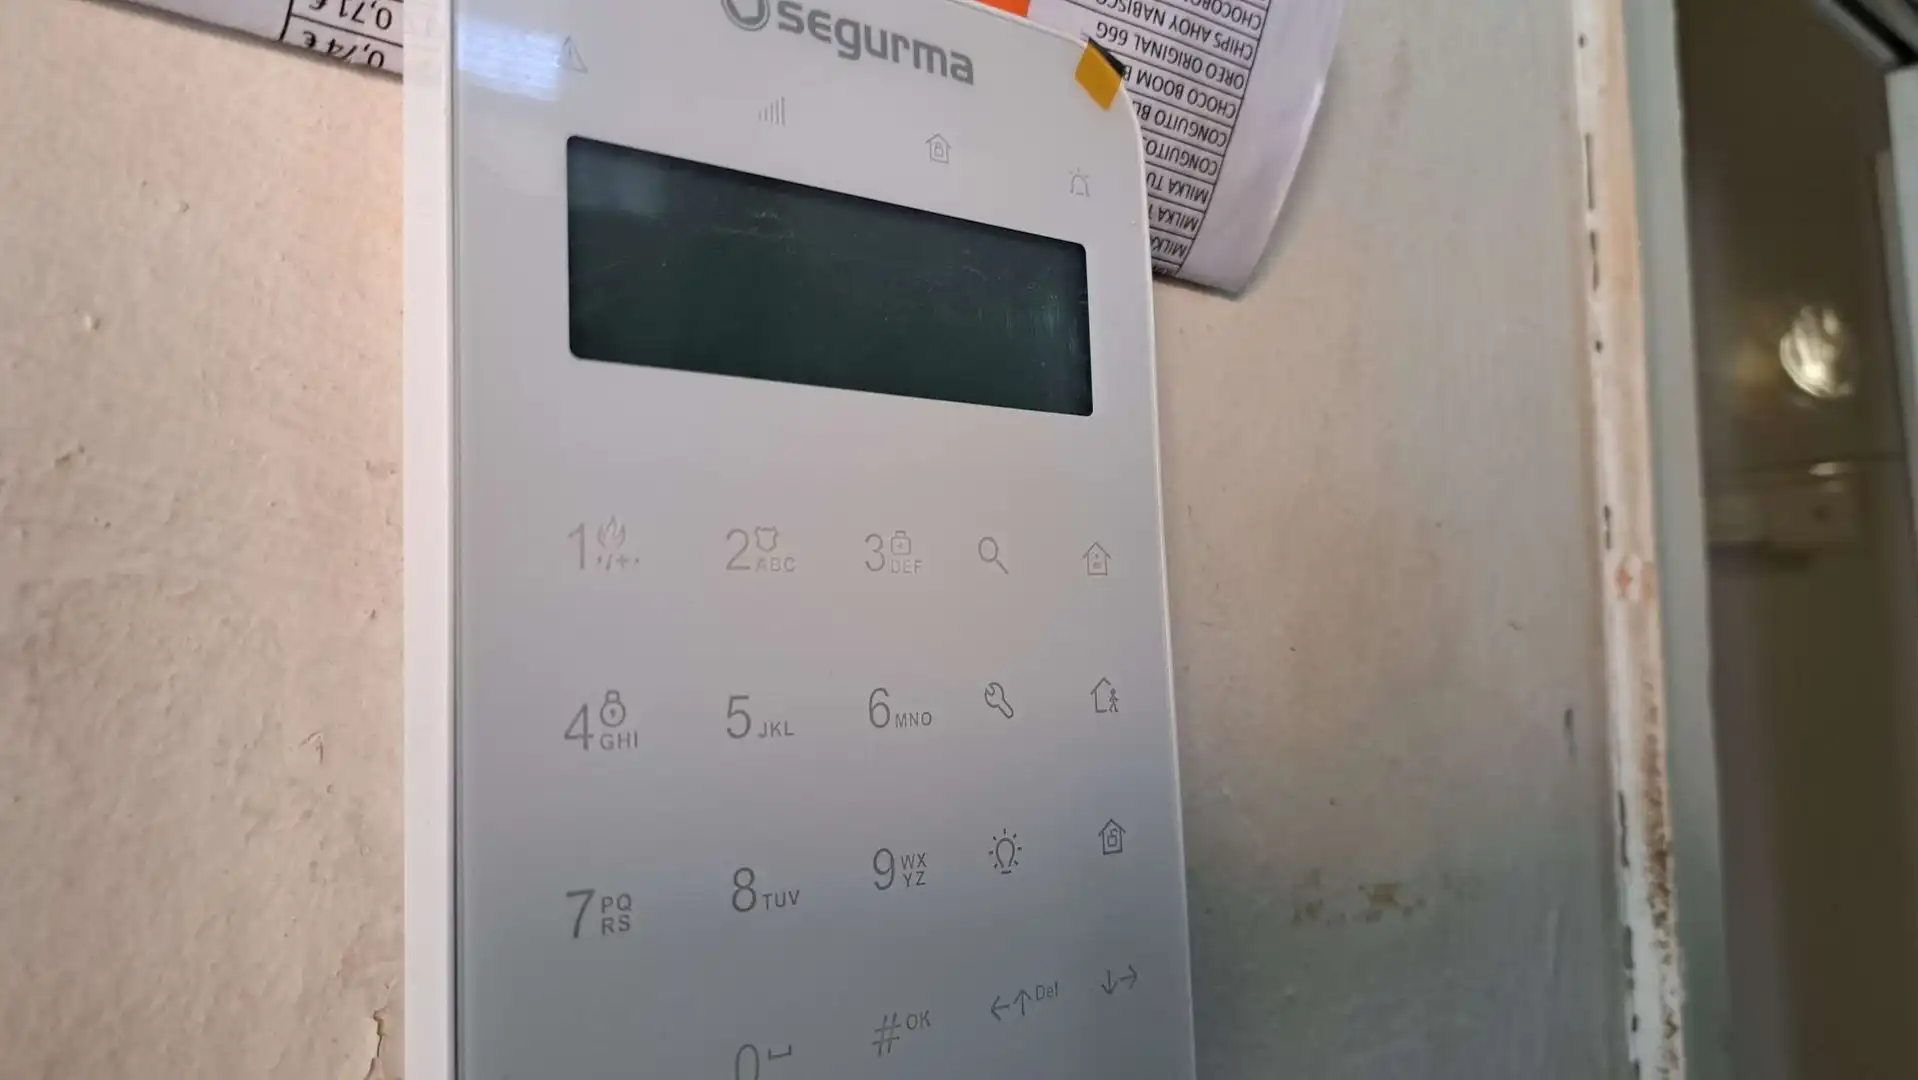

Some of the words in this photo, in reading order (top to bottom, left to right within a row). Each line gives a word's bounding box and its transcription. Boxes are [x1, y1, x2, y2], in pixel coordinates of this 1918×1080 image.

[777, 0, 974, 85] segurma
[1095, 21, 1128, 46] 66G
[1168, 15, 1212, 43] AHOY
[1213, 32, 1253, 61] CHIPS
[1134, 33, 1203, 74] ORIGINAL
[1136, 67, 1184, 100] BOOM
[1205, 62, 1244, 90] OREO
[1187, 88, 1236, 119] CHOCO
[1154, 110, 1228, 148] CONGUITO
[1142, 136, 1218, 176] CONGUITO
[1168, 178, 1209, 205] MILKA
[1158, 206, 1199, 232] MILKA
[567, 522, 585, 569] 1
[725, 528, 750, 571] 2
[755, 554, 796, 573] ABC
[864, 534, 885, 572] 3
[890, 559, 923, 575] DEF
[564, 702, 594, 750] 4
[599, 731, 639, 751] GHI
[726, 695, 751, 739] 5
[757, 719, 795, 739] JKL
[868, 688, 890, 729] 6
[895, 711, 932, 729] MNO
[873, 848, 895, 890] 9
[900, 853, 928, 871] WX
[902, 871, 927, 888] YZ
[731, 867, 757, 912] 8
[761, 889, 800, 911] TUV
[566, 888, 595, 939] 7
[600, 893, 633, 915] PQ
[600, 914, 631, 936] RS
[1035, 981, 1060, 1001] Del
[906, 1010, 931, 1031] OK
